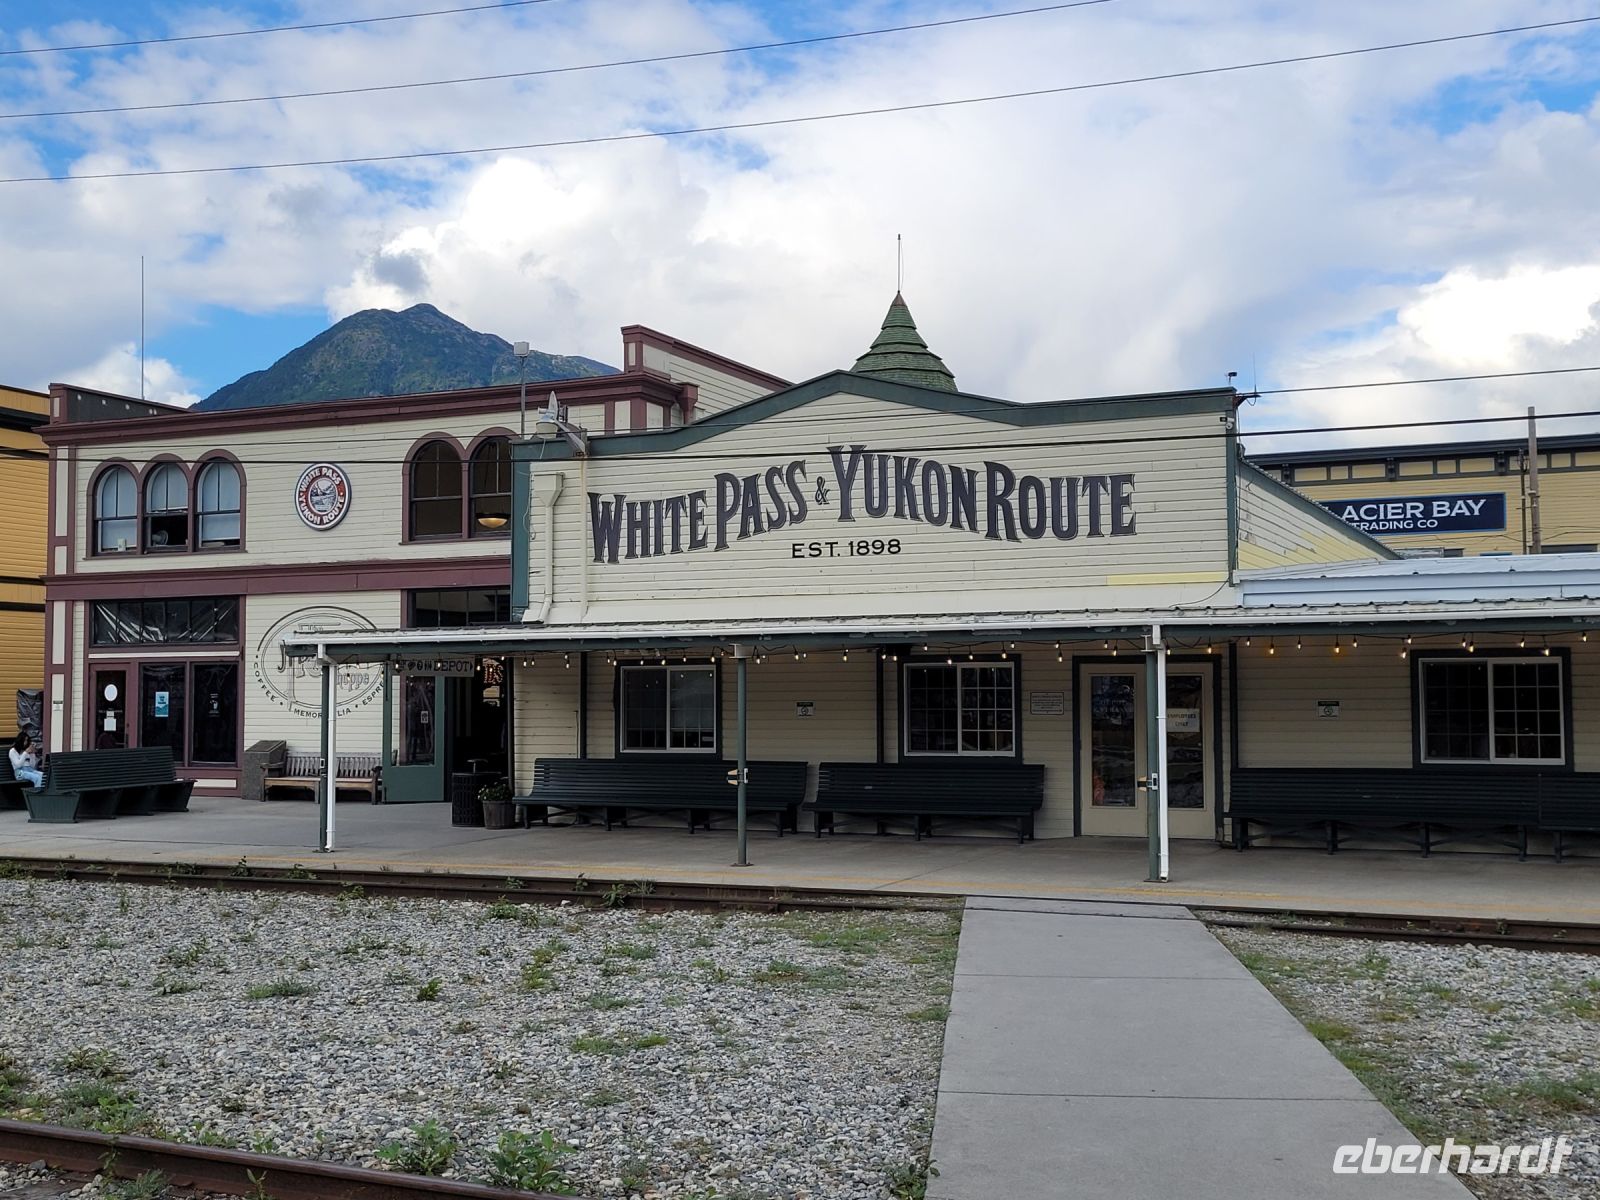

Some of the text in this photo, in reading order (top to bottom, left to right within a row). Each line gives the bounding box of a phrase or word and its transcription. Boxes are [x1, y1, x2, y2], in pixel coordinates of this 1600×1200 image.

[299, 467, 342, 492] WHITE PASS
[298, 493, 345, 525] YUKON ROUTE
[587, 444, 1138, 564] WHITE PASS & YUKON ROUTE
[1341, 499, 1487, 522] ACIER BAY
[1417, 519, 1439, 529] CO
[791, 538, 902, 558] EST. 1898
[434, 660, 470, 672] DEPOT
[254, 662, 276, 702] COFFEE
